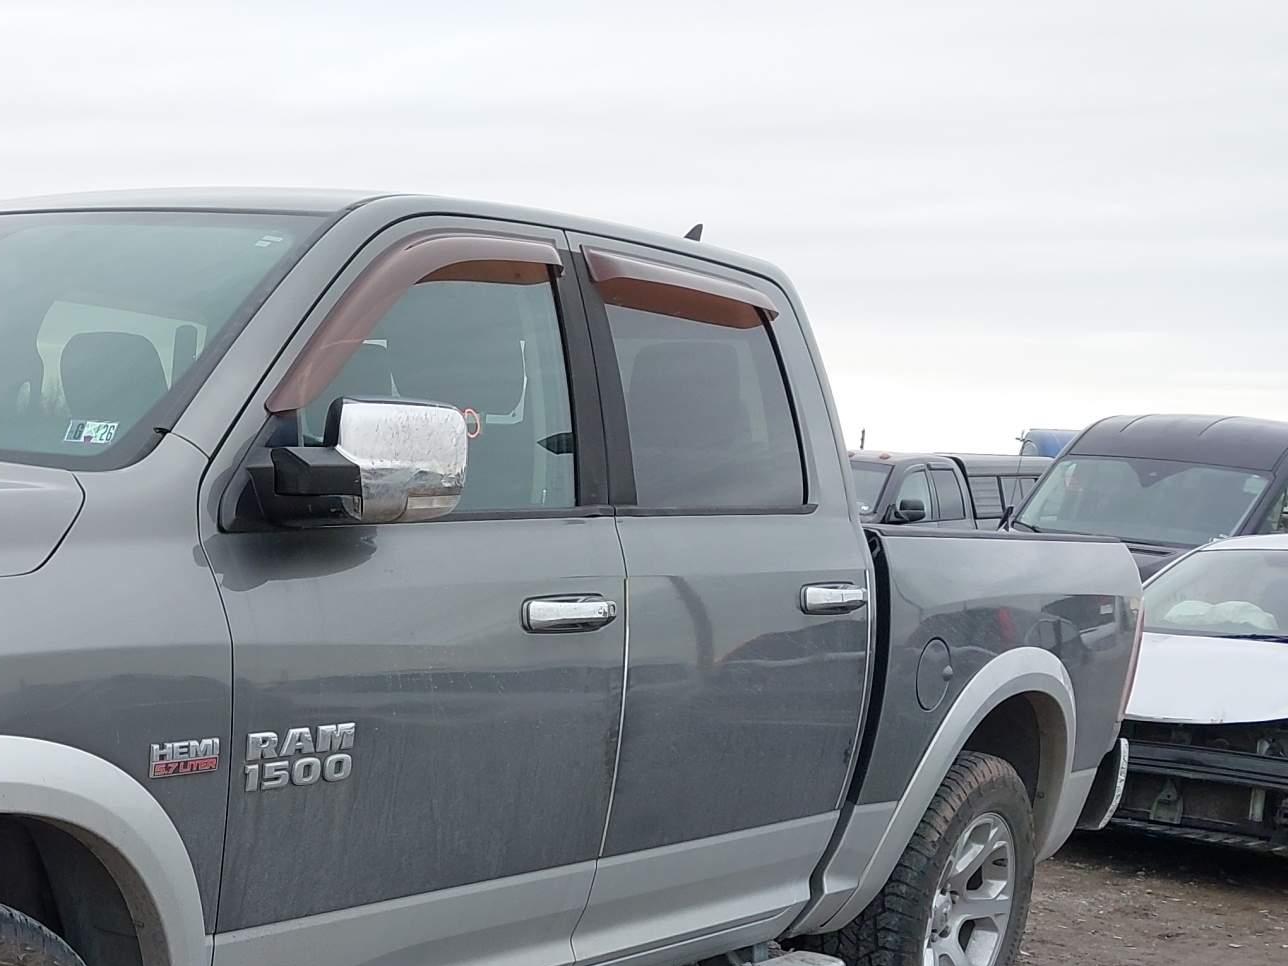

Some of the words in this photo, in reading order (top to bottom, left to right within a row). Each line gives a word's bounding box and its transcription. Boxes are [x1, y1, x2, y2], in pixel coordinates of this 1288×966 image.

[151, 737, 220, 762] HEMI
[246, 722, 356, 761] RAM
[154, 762, 178, 776] 5.7
[178, 758, 217, 773] LITER
[244, 753, 352, 792] 1500
